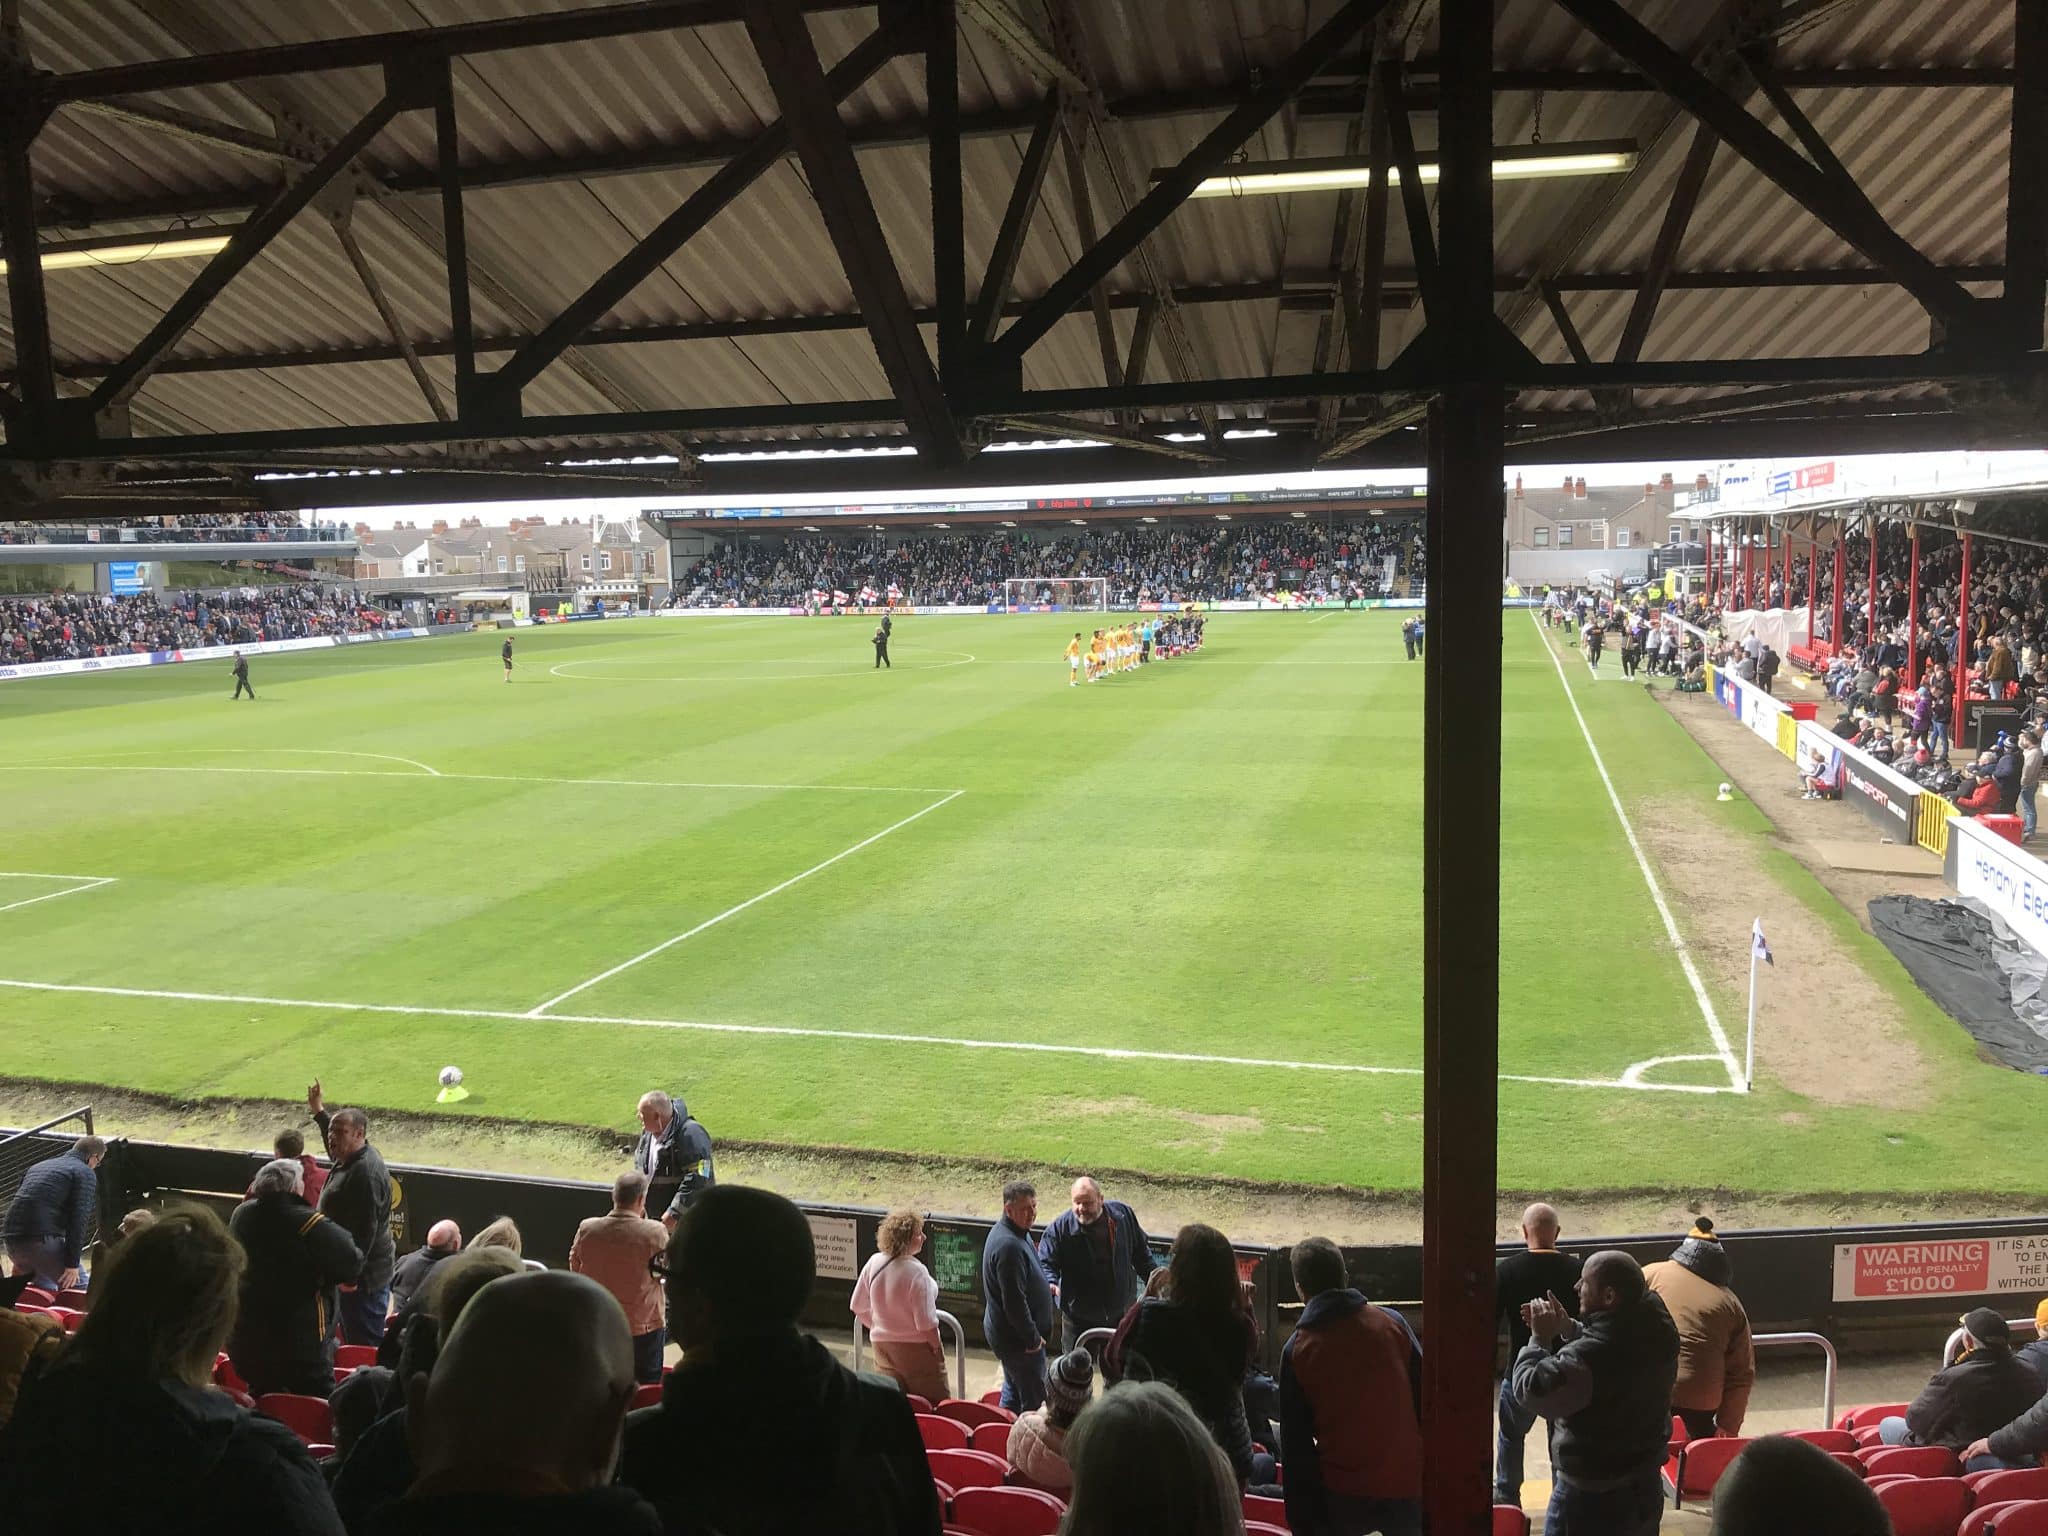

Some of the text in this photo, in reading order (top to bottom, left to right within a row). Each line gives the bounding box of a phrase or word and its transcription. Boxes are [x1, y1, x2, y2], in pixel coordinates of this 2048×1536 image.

[21, 664, 63, 675] INSURANCE
[1975, 851, 2018, 908] Hendry
[1997, 1240, 2009, 1250] IT
[2012, 1239, 2023, 1249] IS
[2027, 1239, 2036, 1249] A
[1862, 1244, 1983, 1266] WARNING
[2014, 1252, 2030, 1262] TO
[1862, 1263, 1980, 1277] MAXIMUM PENALTY
[2018, 1264, 2042, 1275] THE
[1885, 1275, 1955, 1293] £1000
